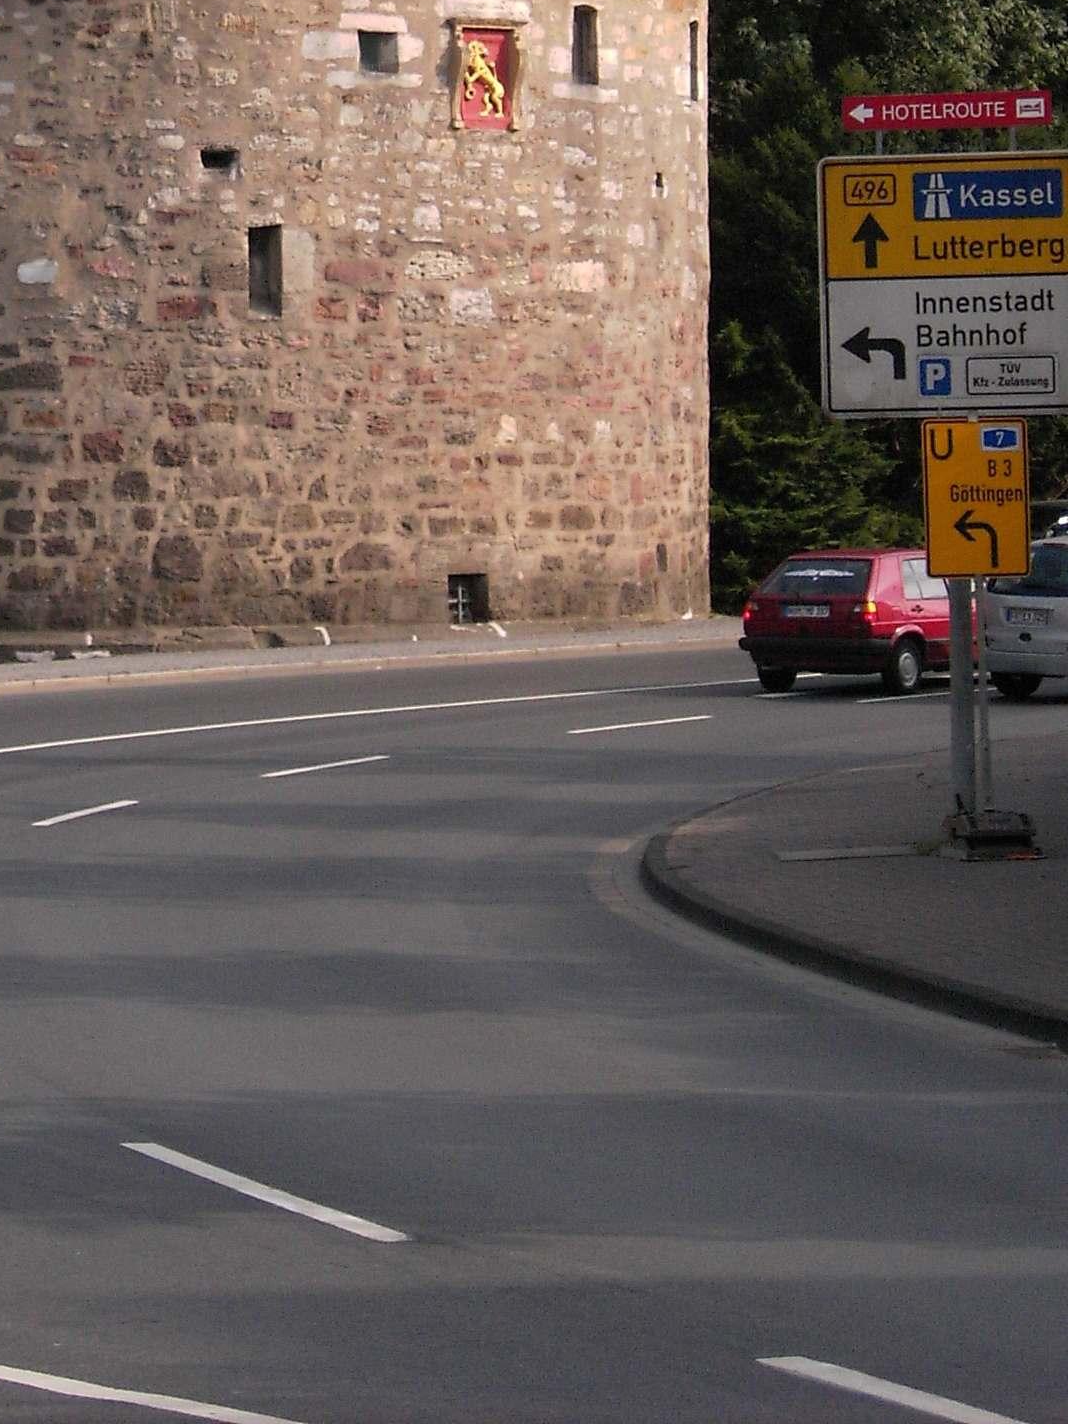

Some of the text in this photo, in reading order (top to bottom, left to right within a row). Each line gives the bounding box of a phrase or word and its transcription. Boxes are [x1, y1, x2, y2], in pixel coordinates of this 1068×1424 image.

[882, 101, 1007, 121] HOTELROUTE
[851, 180, 889, 200] 496
[959, 182, 1054, 208] Kassel
[913, 233, 1065, 263] Lutterberg
[915, 289, 1056, 314] Innenstadt
[916, 322, 1027, 347] Bahnhof
[925, 363, 946, 390] P
[998, 376, 1049, 388] Zulassung
[930, 429, 953, 460] U
[995, 431, 1004, 446] 7
[950, 484, 1023, 507] Göttingen
